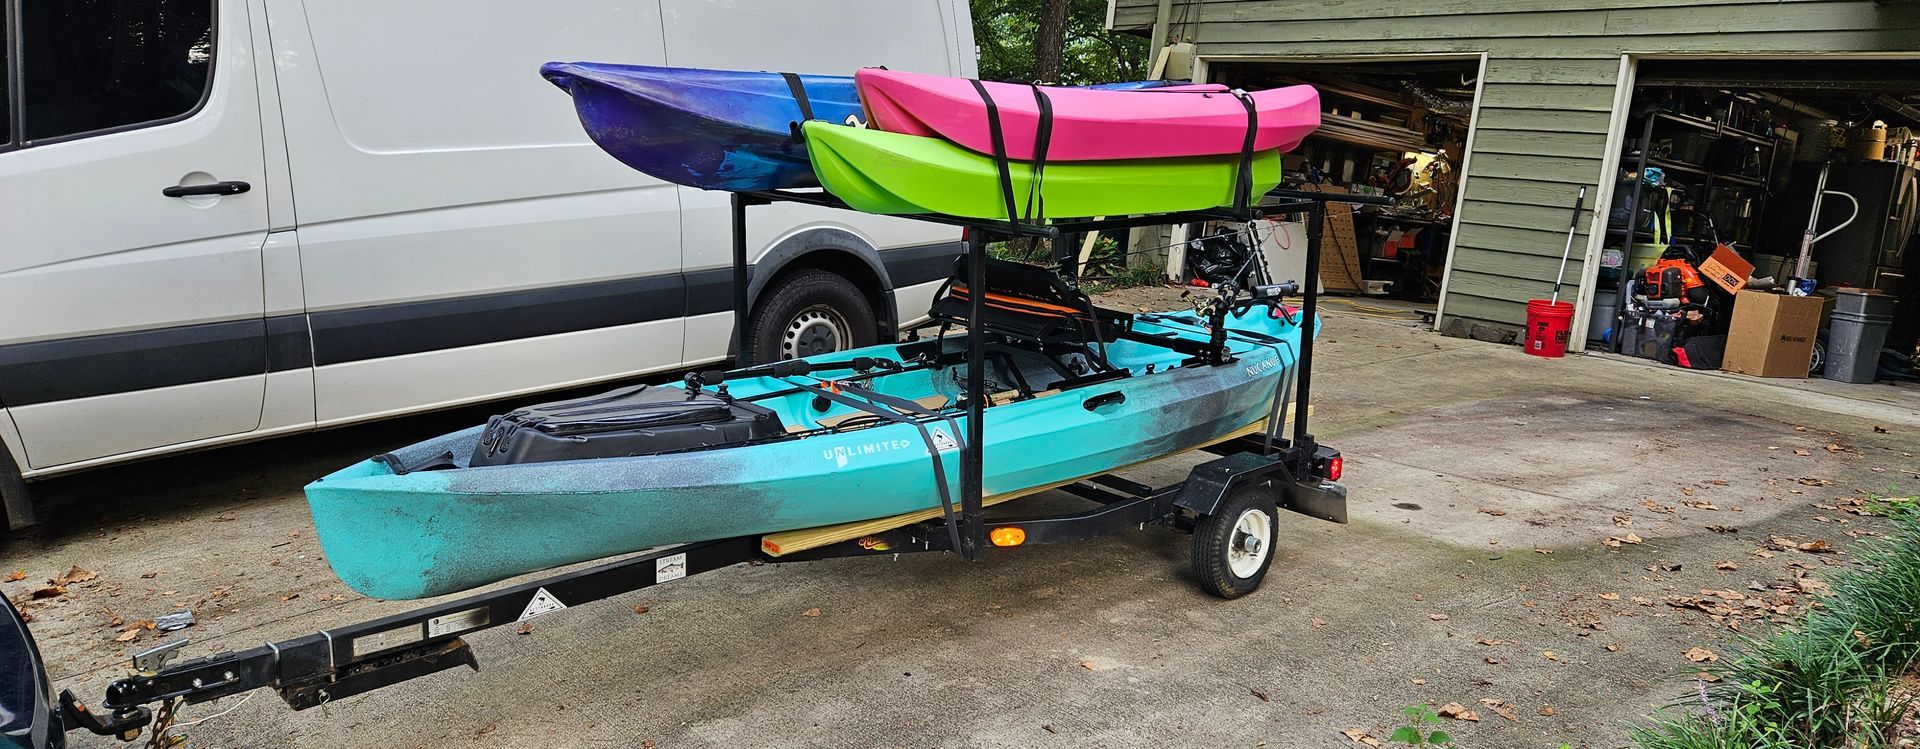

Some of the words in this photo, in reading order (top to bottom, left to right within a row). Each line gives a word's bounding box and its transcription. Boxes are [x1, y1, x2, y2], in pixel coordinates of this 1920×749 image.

[1245, 355, 1280, 377] NUCANOE
[823, 440, 909, 468] UNLIMITED
[659, 555, 682, 564] STREAM
